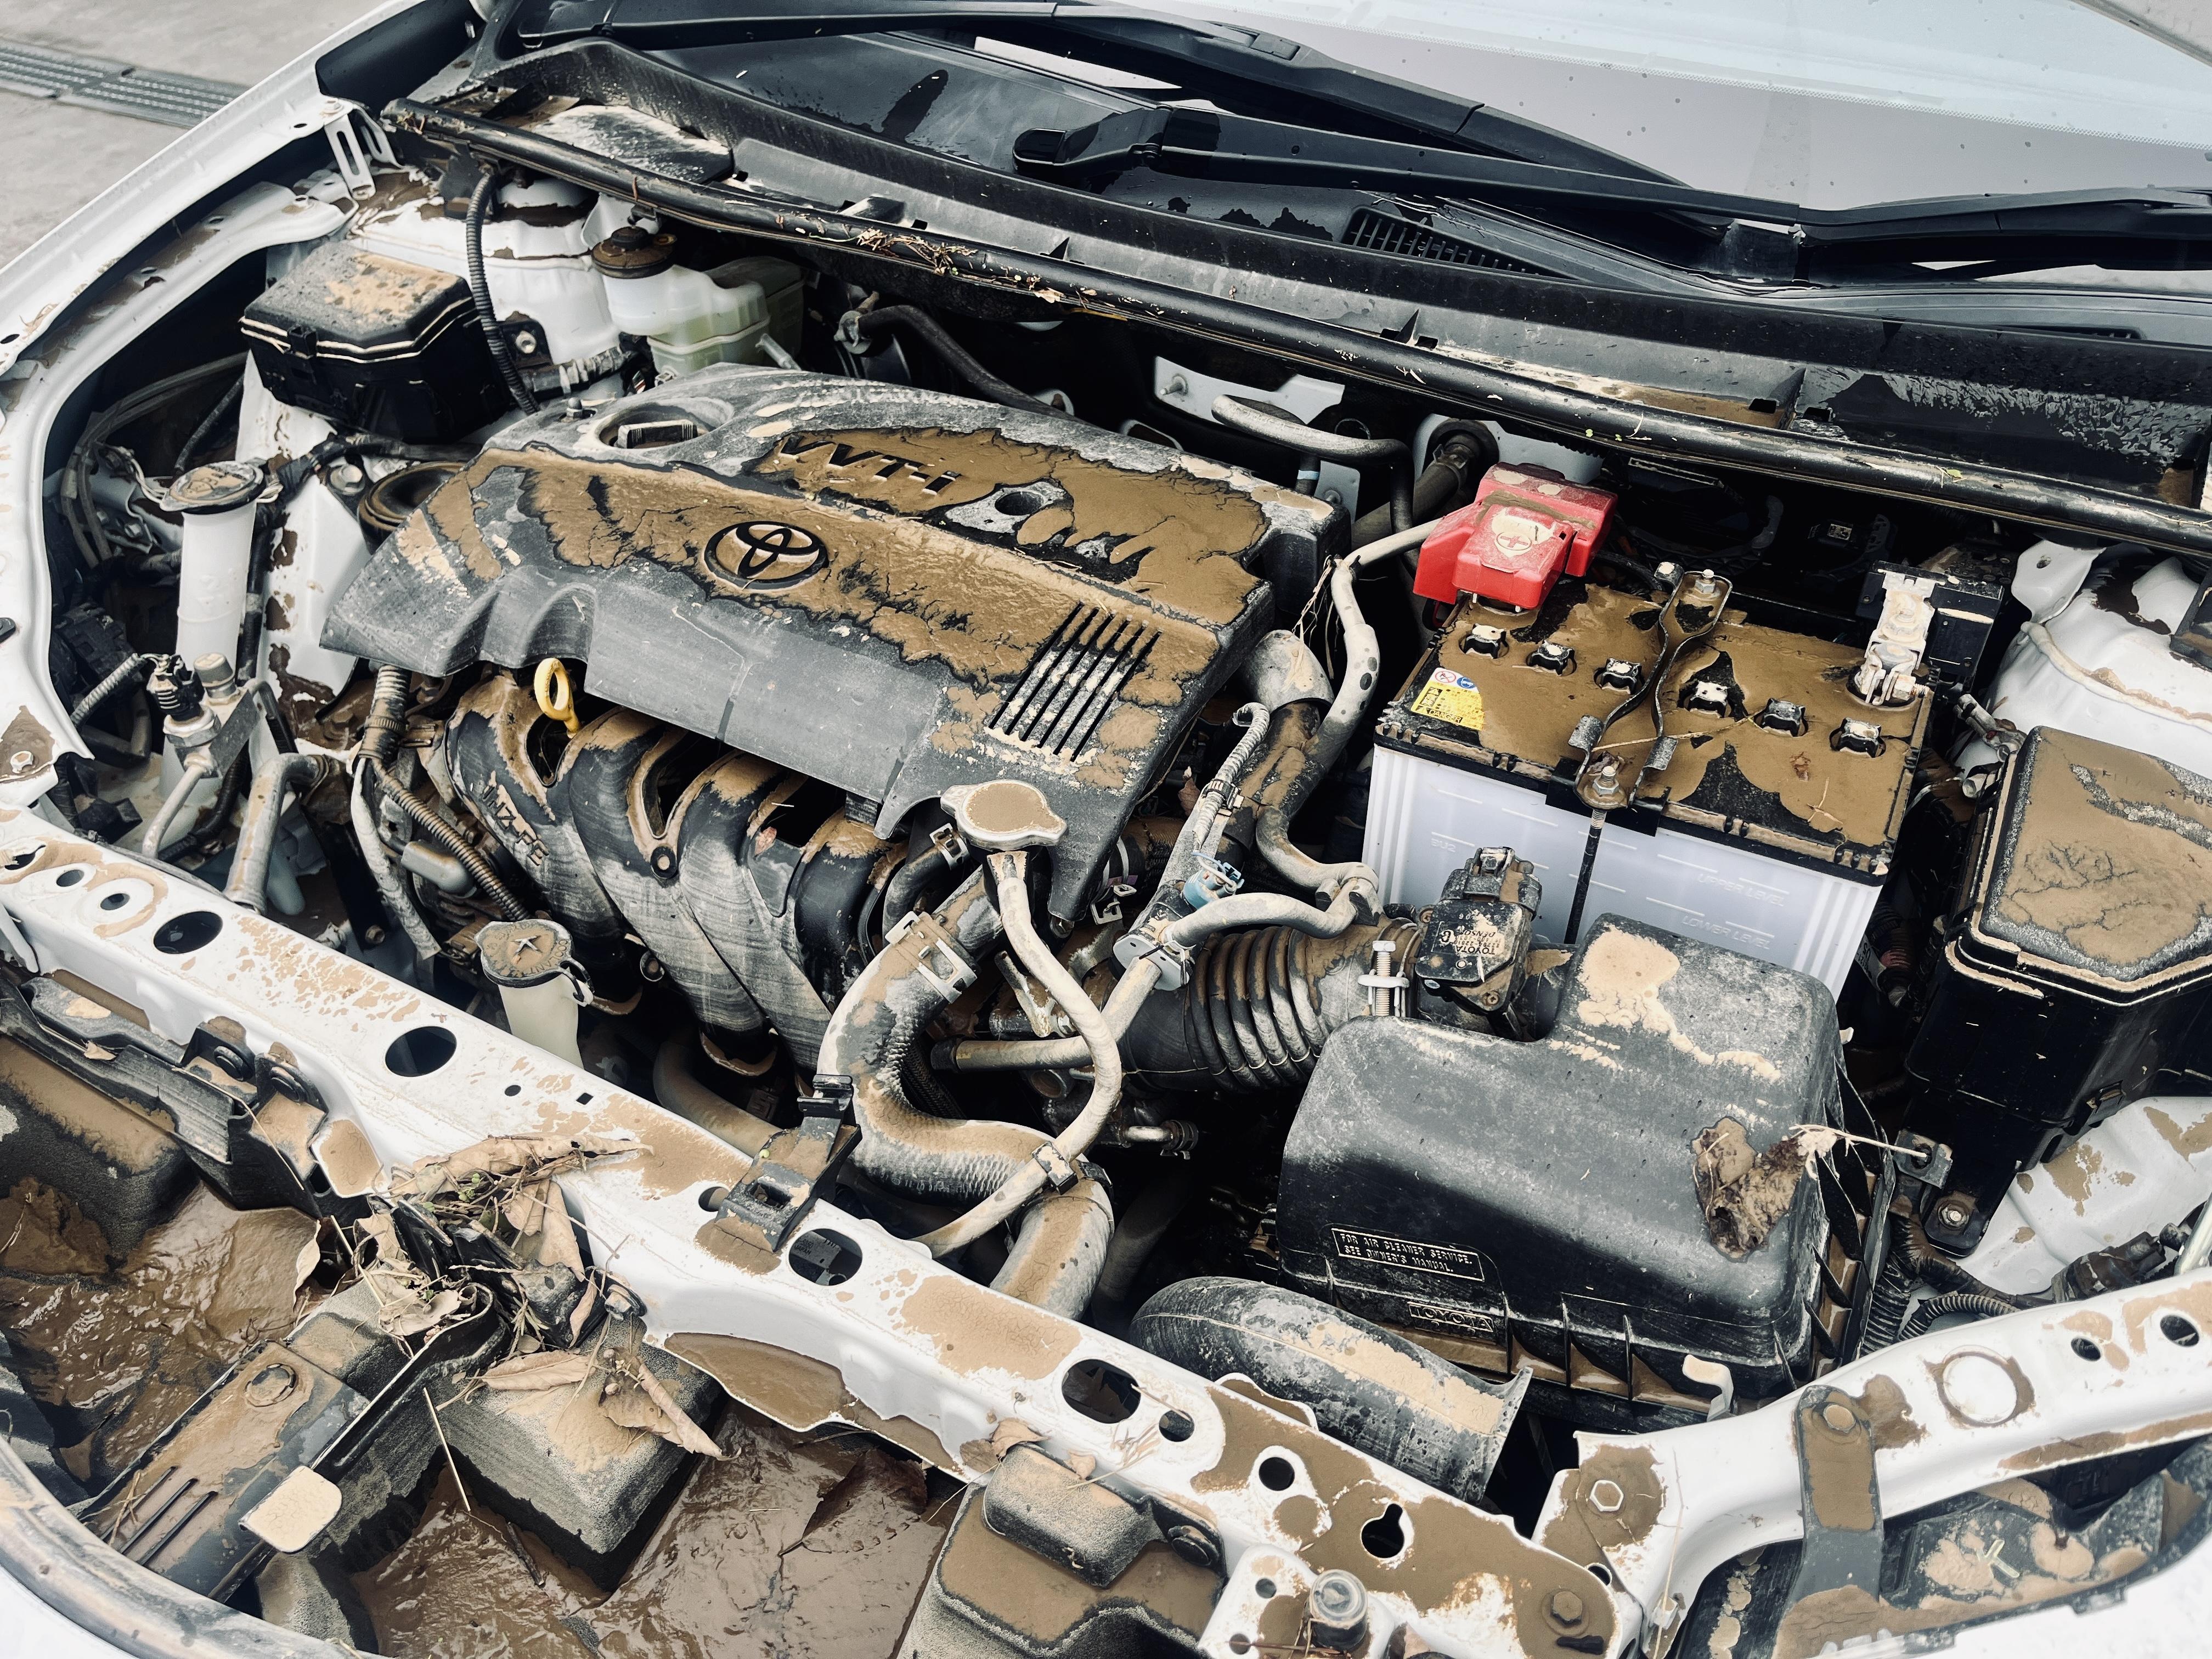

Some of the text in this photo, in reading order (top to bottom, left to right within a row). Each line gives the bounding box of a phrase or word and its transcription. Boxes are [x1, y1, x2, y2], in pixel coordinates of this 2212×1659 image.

[1429, 710, 1462, 724] DANGER
[1697, 873, 1785, 907] UPPER LEVEL
[1681, 915, 1771, 950] LOWER LEVEL
[526, 938, 568, 974] COOLANT
[1455, 945, 1496, 955] TOYOTA
[1340, 1233, 1472, 1265] FOR AIR CLEANER SERVICE.
[1344, 1245, 1454, 1273] SEE OWNER'S MANUAL.
[1409, 1304, 1493, 1333] TOYOTA
